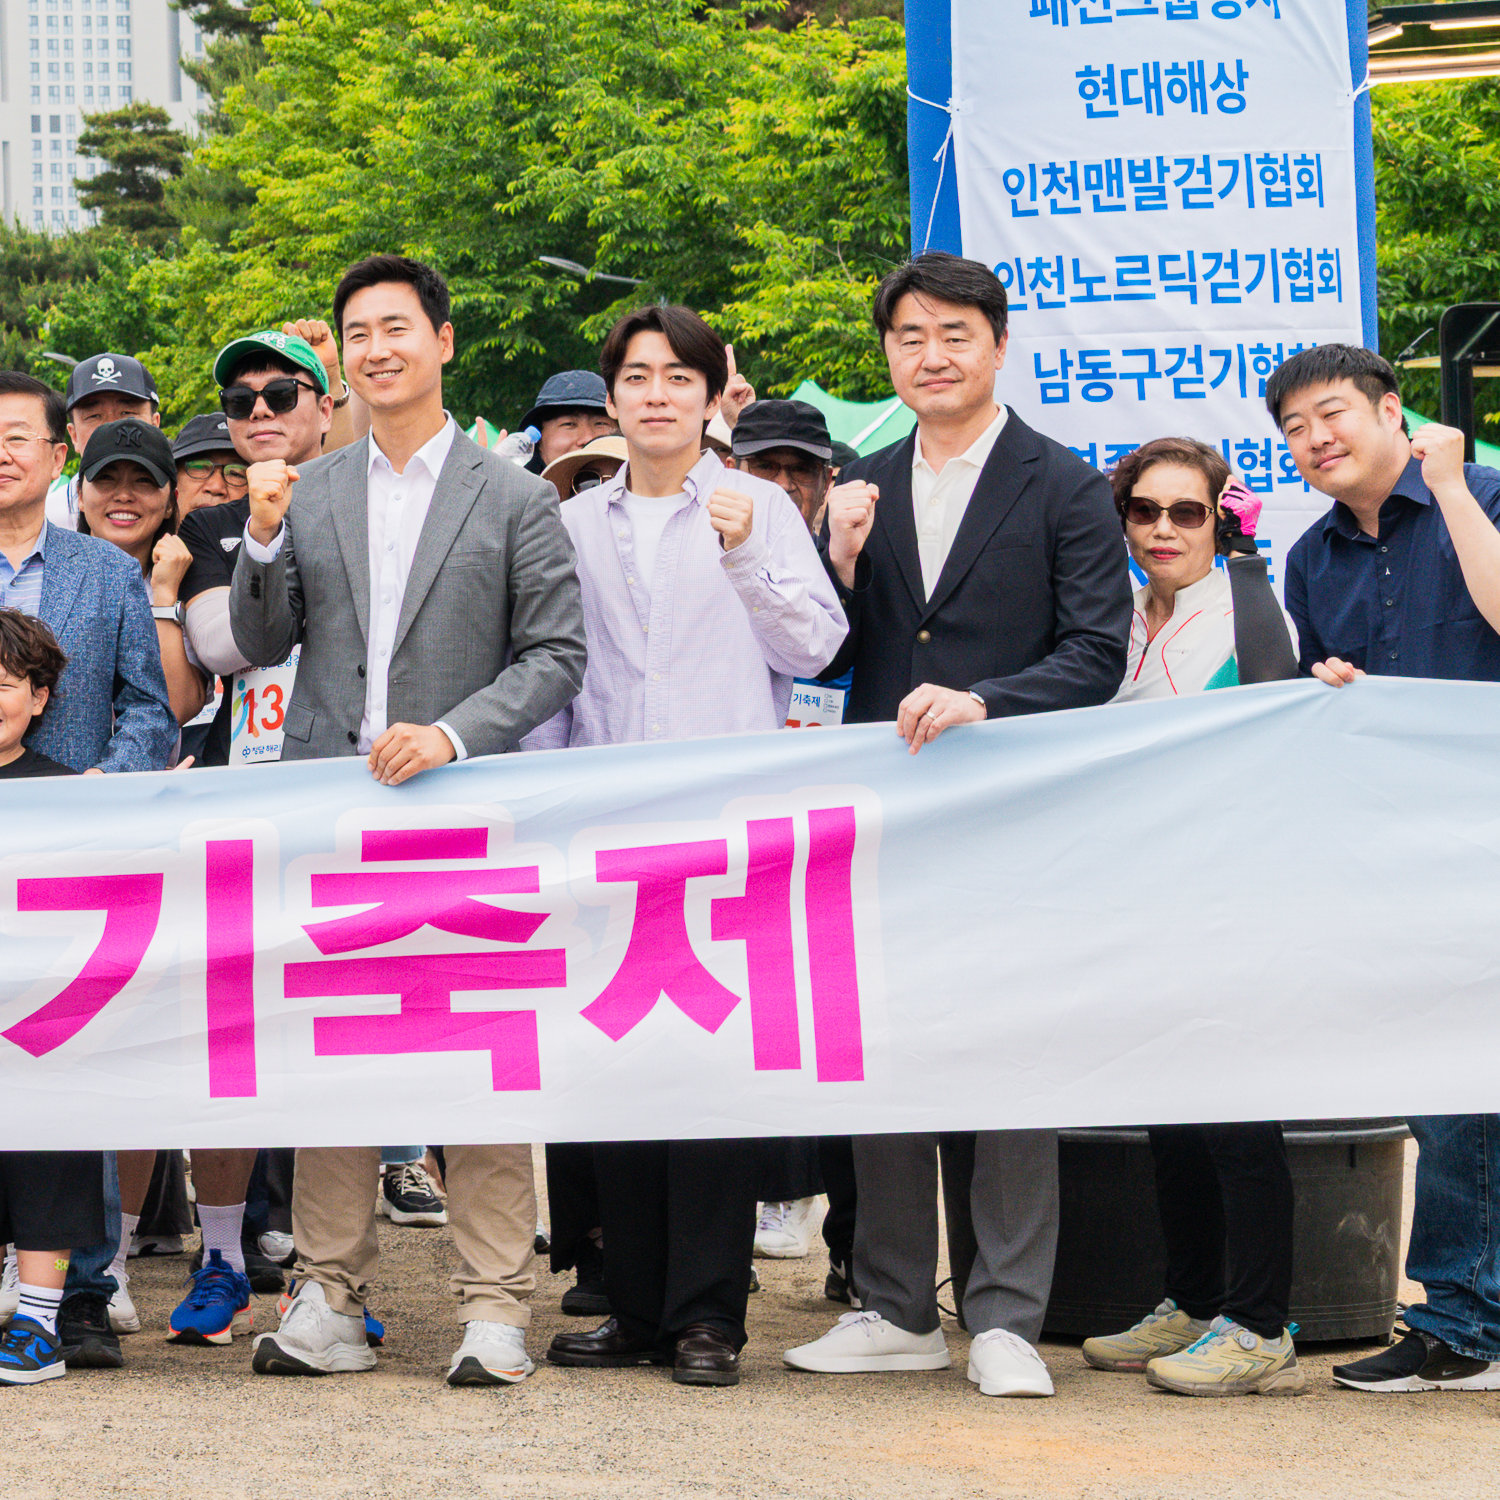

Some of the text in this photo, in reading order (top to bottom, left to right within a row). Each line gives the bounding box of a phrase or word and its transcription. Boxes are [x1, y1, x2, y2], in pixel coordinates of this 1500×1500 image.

[1075, 58, 1249, 119] 현대해상
[1002, 152, 1325, 218] 인천맨발걷기협회
[994, 247, 1343, 312] 인천노르딕걷기협회
[1033, 342, 1318, 405] 남동구걷기협
